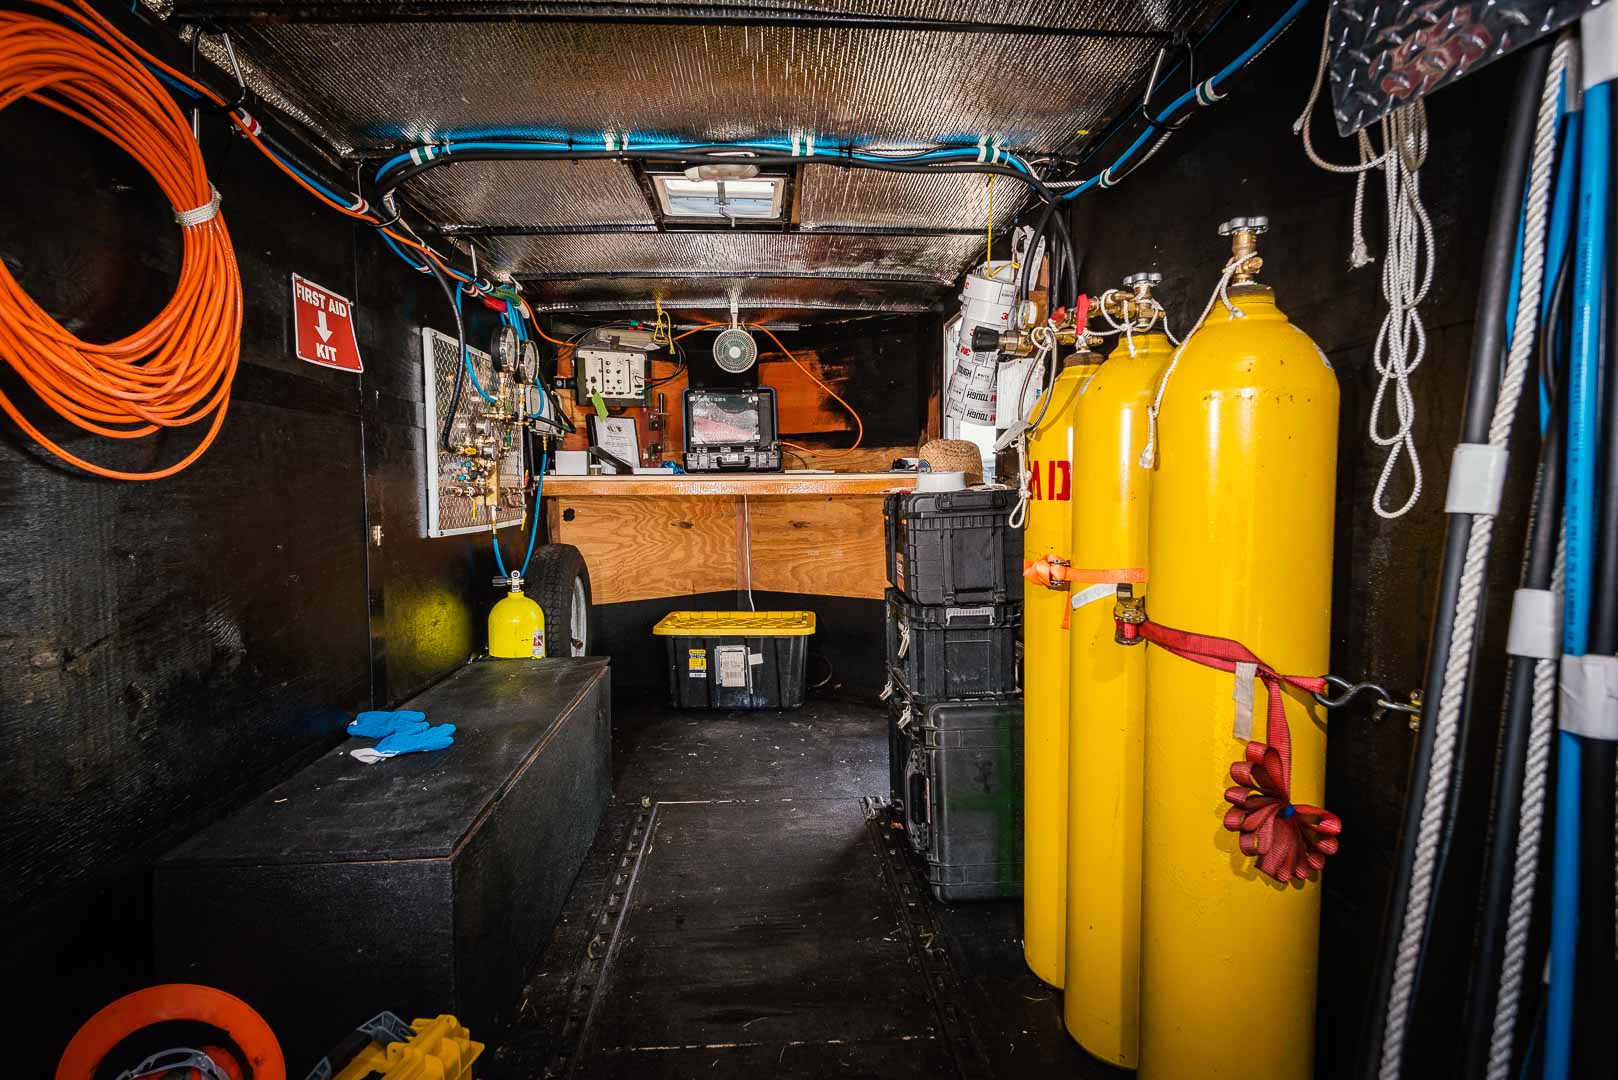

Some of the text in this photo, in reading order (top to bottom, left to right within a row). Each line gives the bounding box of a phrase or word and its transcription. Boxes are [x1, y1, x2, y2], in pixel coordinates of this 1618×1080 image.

[296, 282, 347, 317] FIRST AID
[315, 342, 337, 361] KIT
[966, 390, 989, 402] TOUGH
[966, 409, 988, 421] TOUGH
